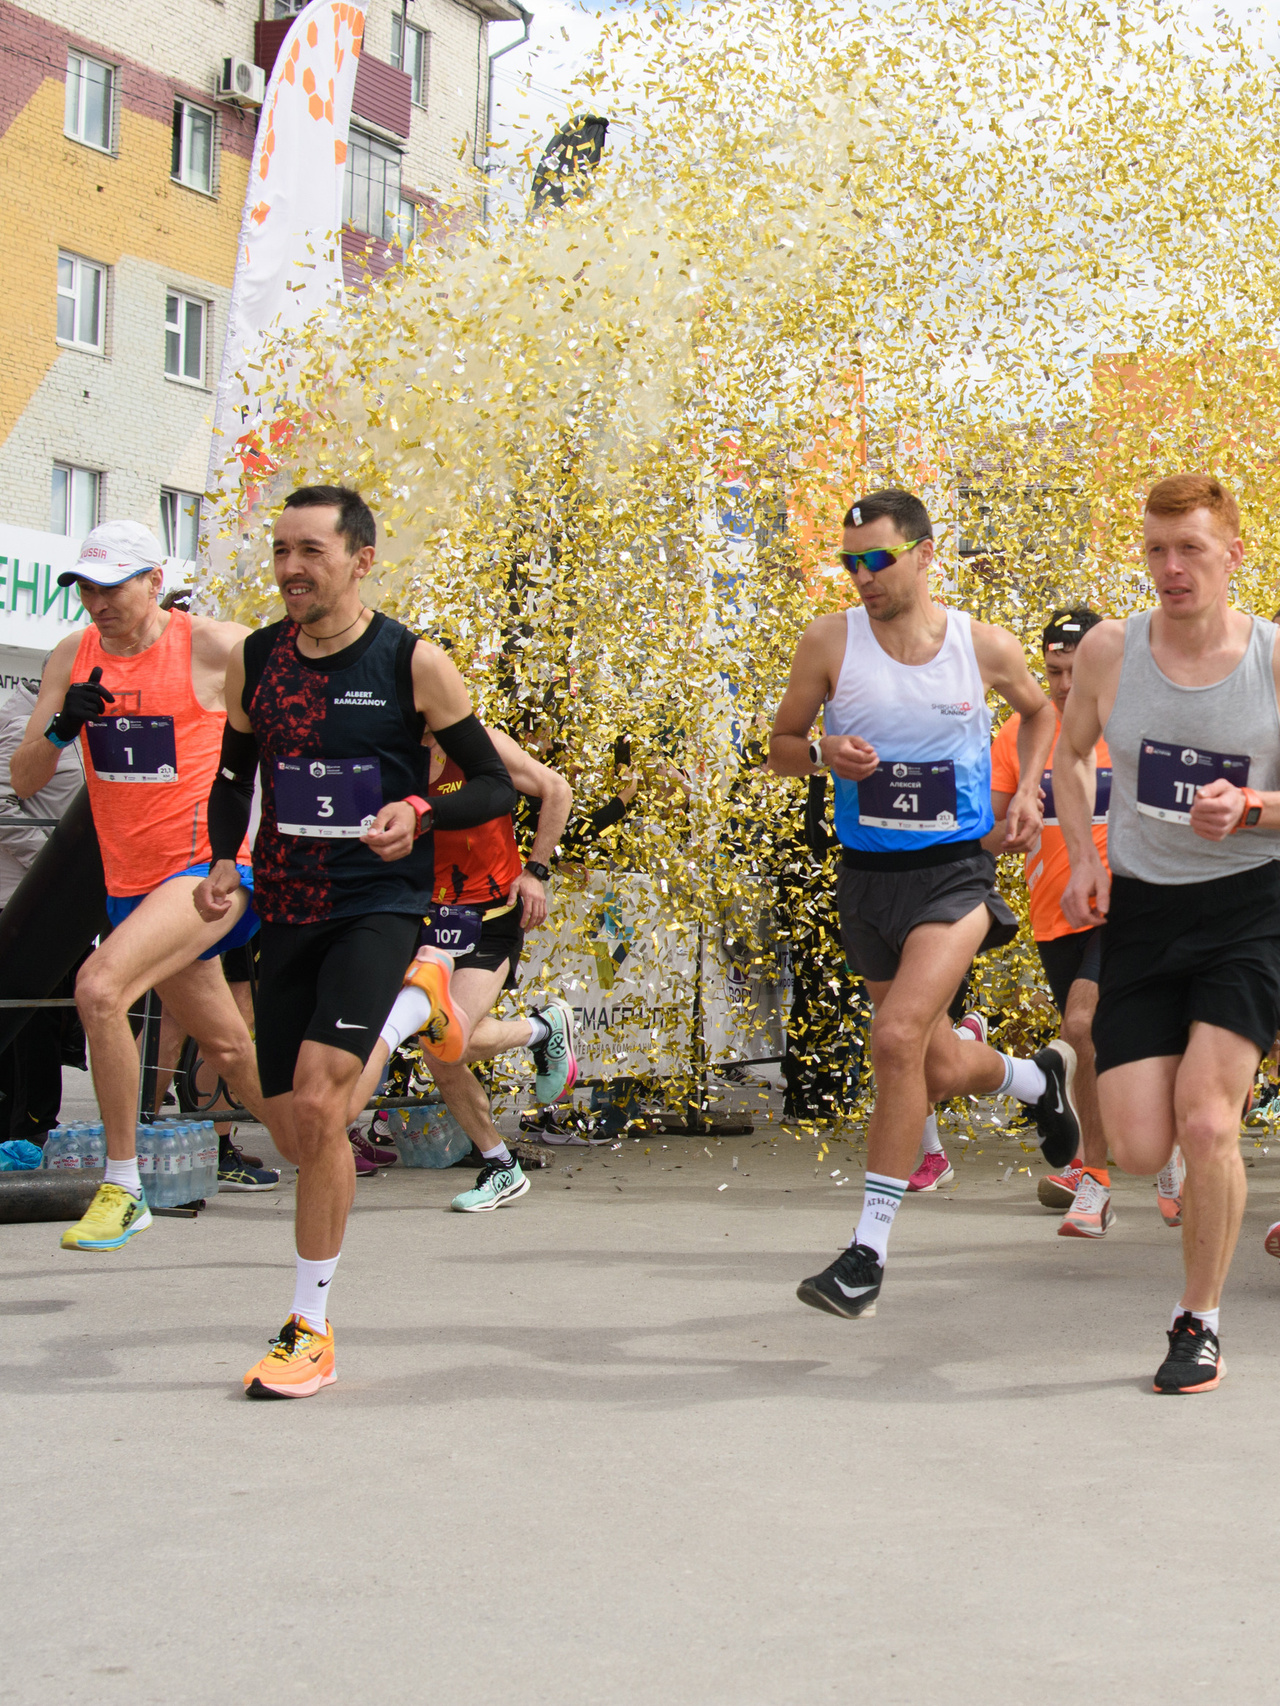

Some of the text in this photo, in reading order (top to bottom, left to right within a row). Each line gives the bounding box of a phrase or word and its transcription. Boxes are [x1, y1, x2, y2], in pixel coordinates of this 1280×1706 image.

[333, 698, 387, 706] RAMAZANOV
[345, 690, 373, 698] ALBERT
[124, 747, 133, 766] 1
[889, 781, 922, 789] АЛЕКСЕЙ
[316, 796, 334, 818] 3
[892, 793, 919, 813] 41
[435, 928, 462, 944] 107
